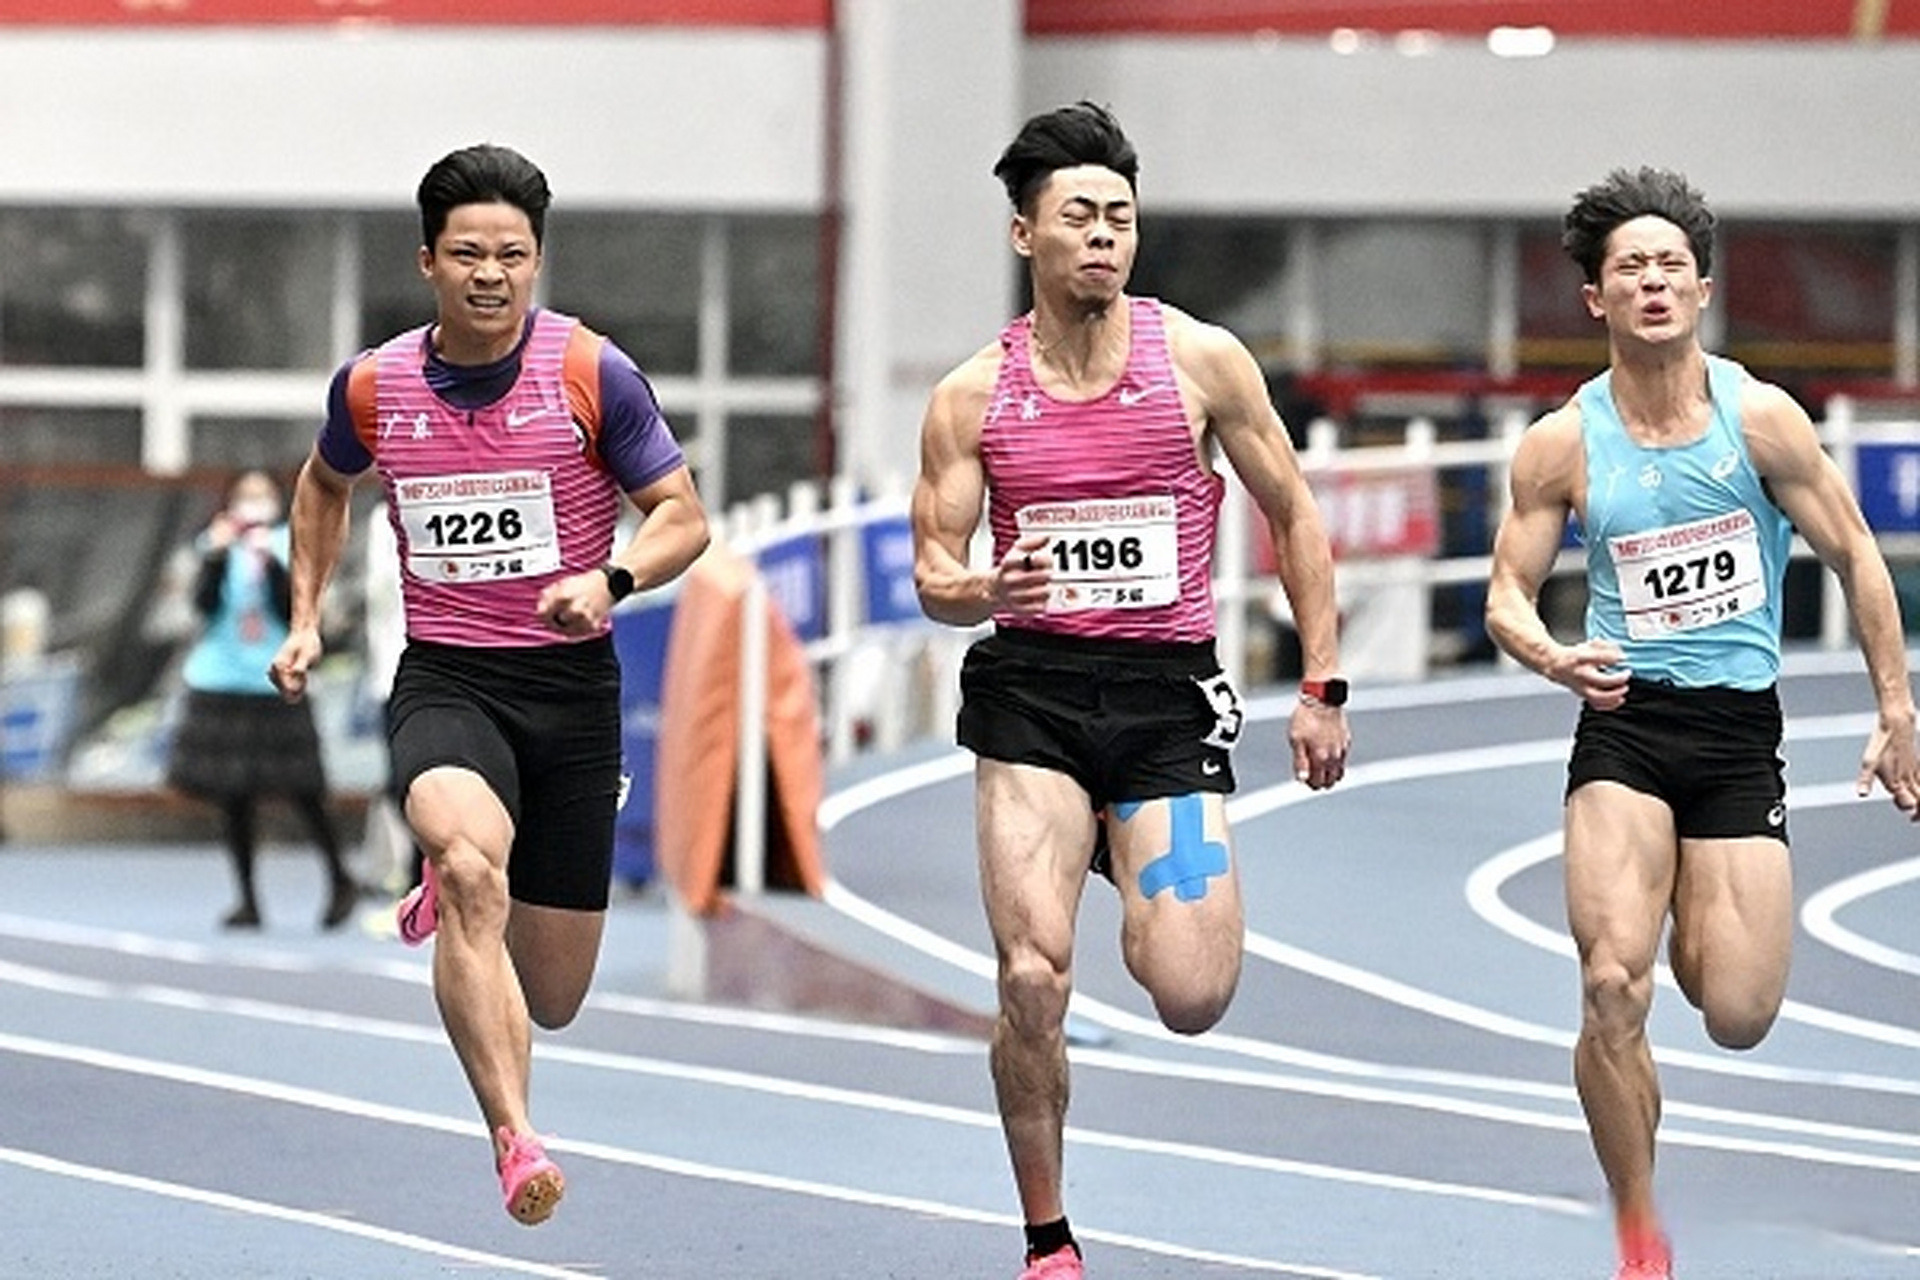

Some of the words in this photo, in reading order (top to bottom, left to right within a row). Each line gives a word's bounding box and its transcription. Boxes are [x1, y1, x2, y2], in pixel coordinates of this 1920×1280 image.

[425, 508, 522, 547] 1226
[1052, 537, 1143, 571] 1196
[1644, 550, 1735, 599] 1279
